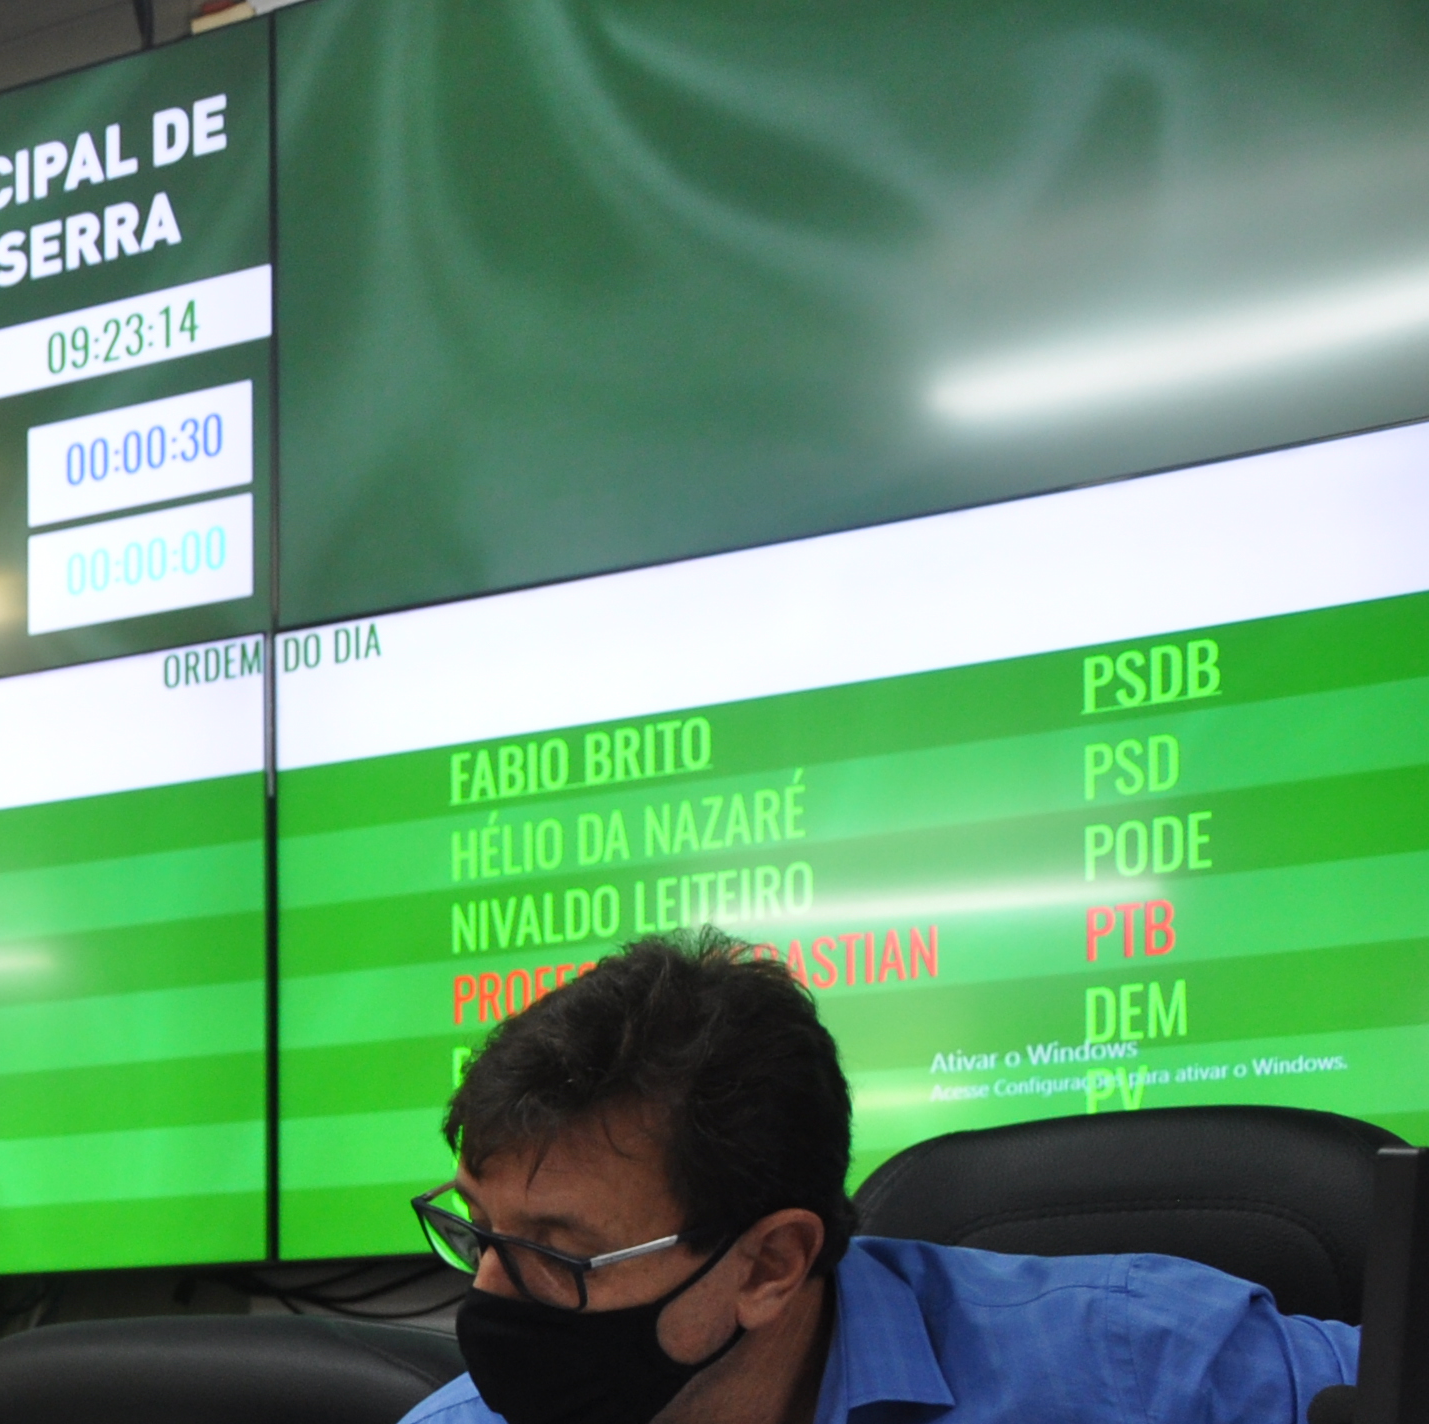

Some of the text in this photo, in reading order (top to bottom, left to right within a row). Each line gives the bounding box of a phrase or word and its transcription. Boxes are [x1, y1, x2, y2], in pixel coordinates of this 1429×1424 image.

[152, 93, 228, 168] DE
[46, 299, 200, 376] 09:23:14
[65, 412, 225, 487] 00:00:30
[65, 525, 227, 597] 00:00:00
[163, 622, 381, 689] ORDEM DO DIA
[1082, 637, 1222, 711] PSDB
[449, 716, 713, 803] FABIO BRITO
[1084, 733, 1180, 801] PSD
[450, 770, 807, 881] HÉLIO DA NAZARÉ
[1084, 811, 1214, 881] PODE
[450, 861, 815, 954] NIVALDO LEITEIRO
[1085, 899, 1176, 962] PTB
[1084, 979, 1188, 1044] DEM
[930, 1040, 1139, 1074] Ativar o Windows
[931, 1083, 990, 1102] Acesse
[1175, 1062, 1229, 1082] ativar
[1234, 1062, 1247, 1078] o
[1252, 1053, 1349, 1077] Windows.
[1086, 1065, 1149, 1116] PV
